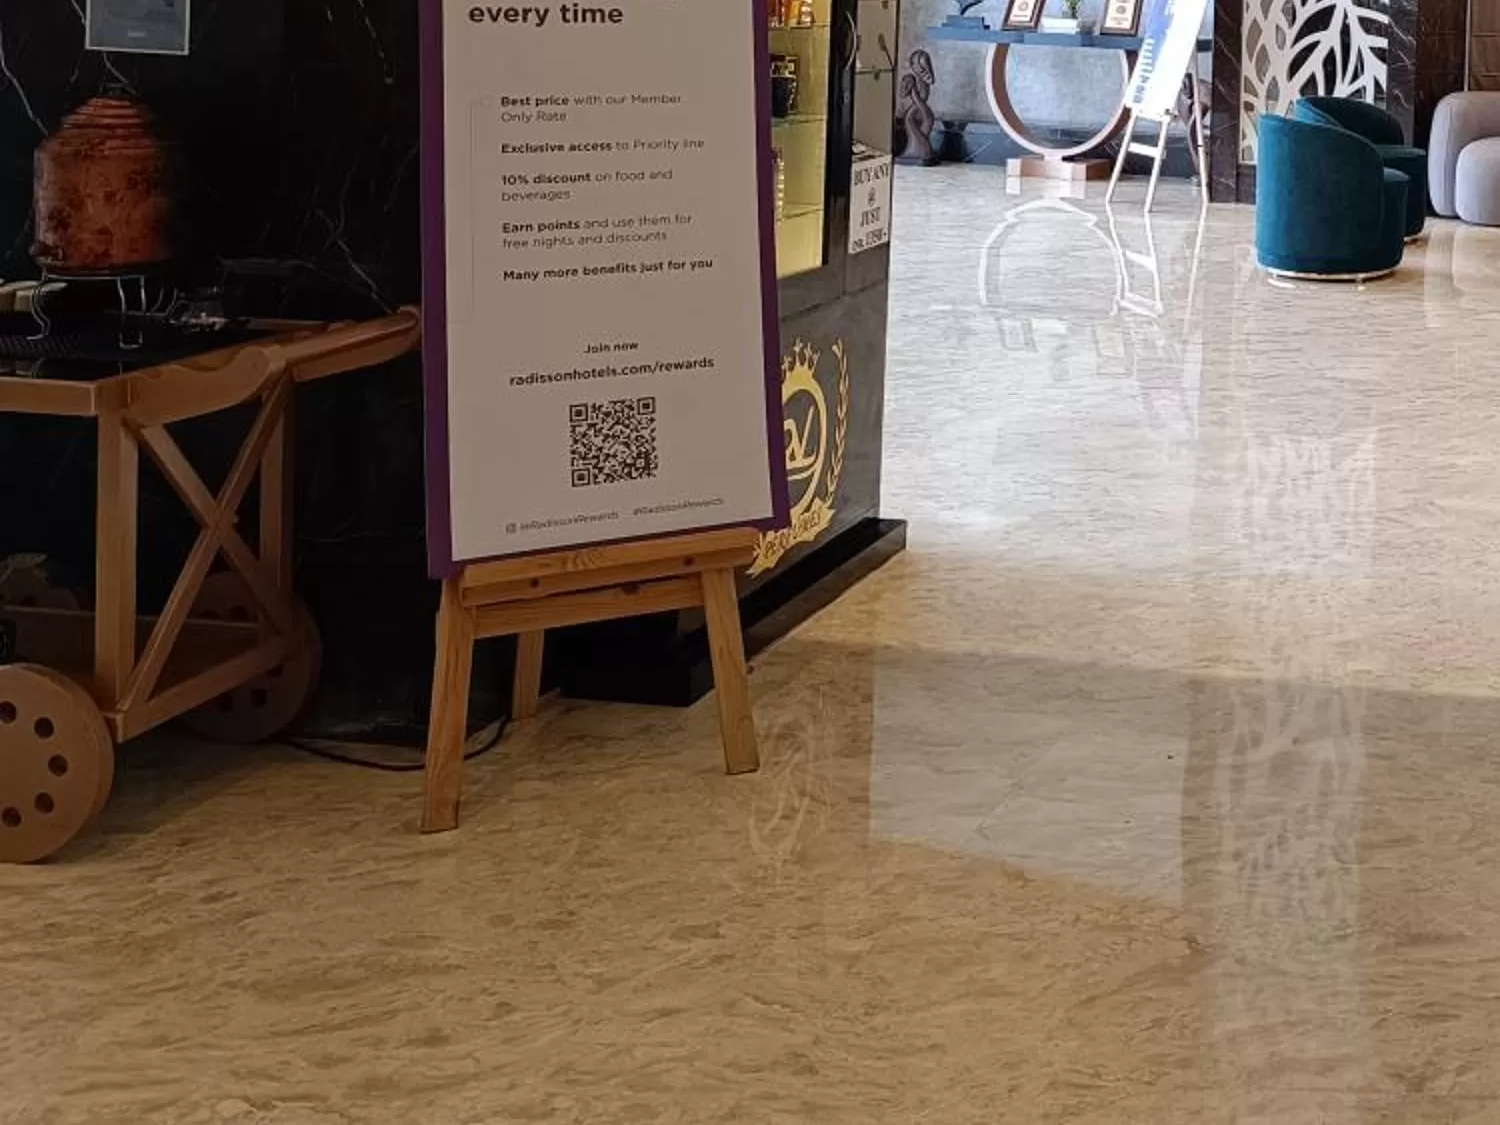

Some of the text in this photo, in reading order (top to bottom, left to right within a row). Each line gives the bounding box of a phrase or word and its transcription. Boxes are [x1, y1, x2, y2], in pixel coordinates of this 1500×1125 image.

[468, 3, 624, 27] every time
[501, 94, 681, 107] Best price with our Member
[501, 111, 567, 123] Only Rate
[501, 138, 705, 154] Exclusive access to Priority line
[502, 170, 673, 186] 10% discount on food and
[501, 190, 571, 202] beverages
[502, 213, 692, 233] Earn points and use them for
[503, 231, 667, 250] free nights and discounts
[503, 259, 713, 282] Many more benefits just for you
[584, 341, 639, 354] Join now
[509, 357, 715, 386] radissonhotels.com/rewards
